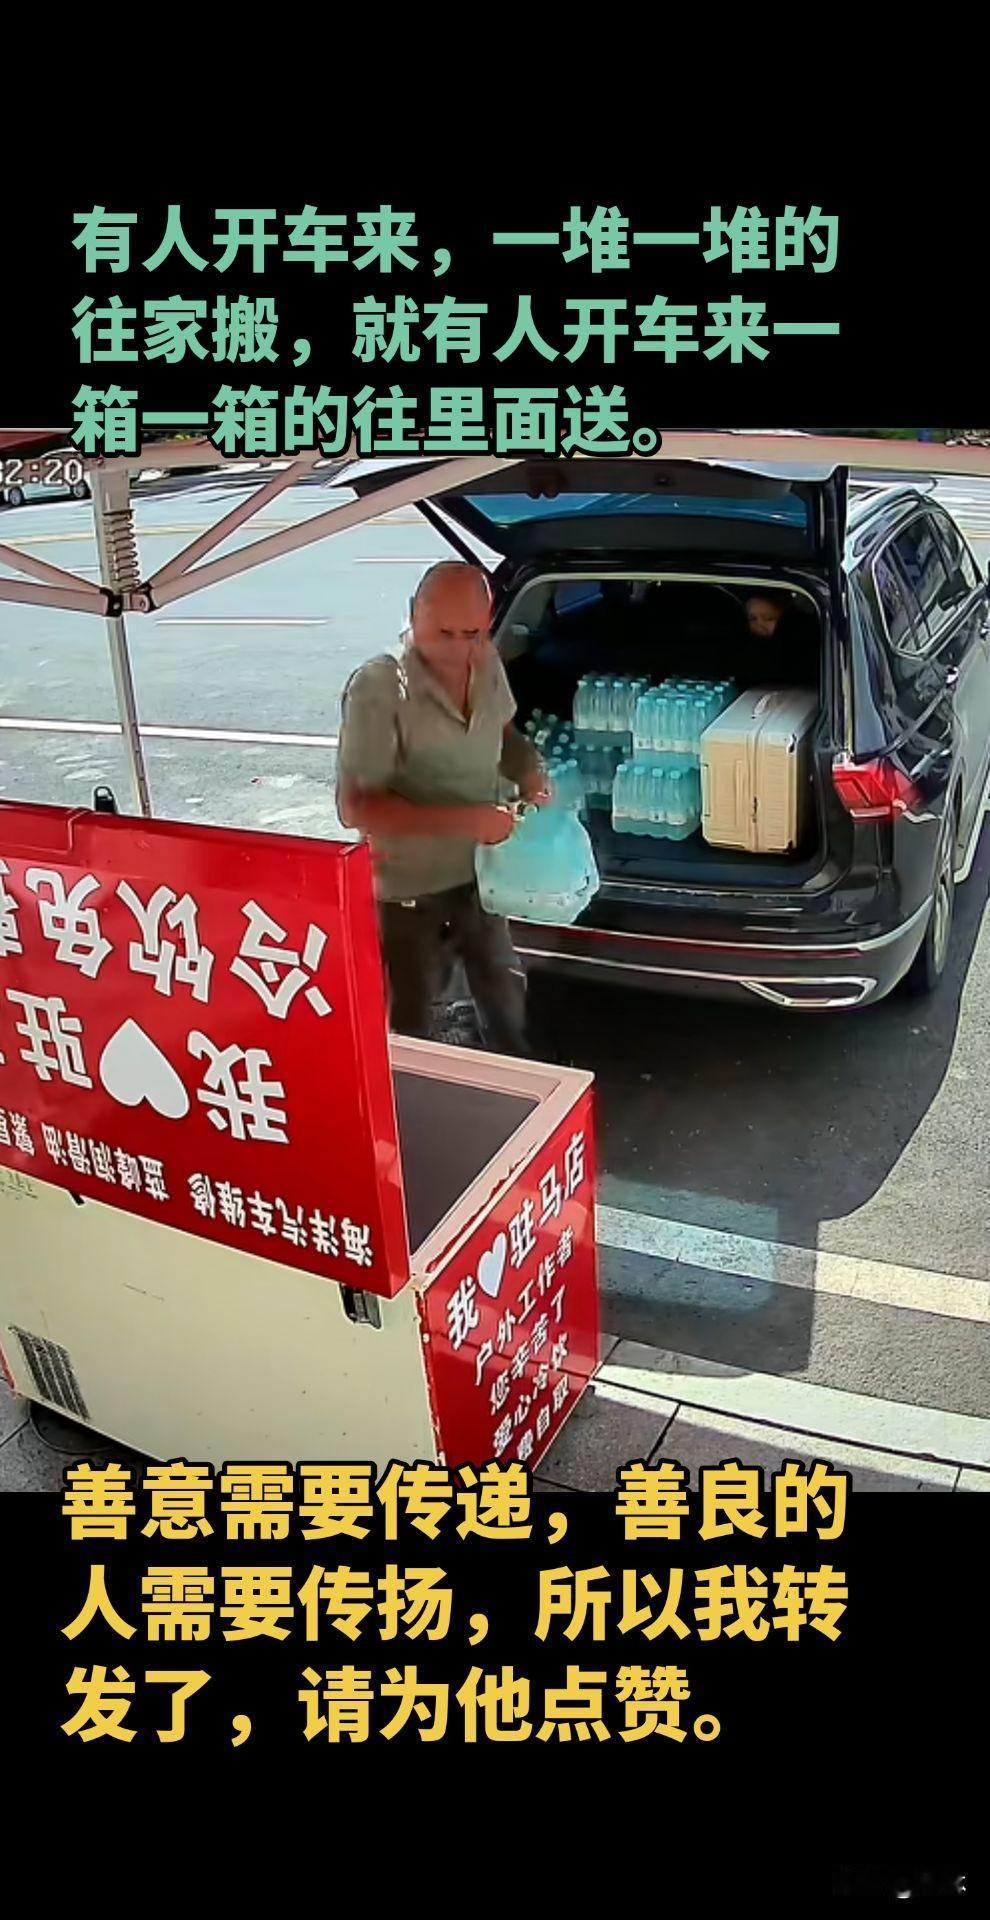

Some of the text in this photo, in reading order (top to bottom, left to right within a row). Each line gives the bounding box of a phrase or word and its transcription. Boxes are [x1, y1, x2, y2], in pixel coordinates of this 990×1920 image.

[0, 988, 289, 1144] 我 驻
[187, 1173, 373, 1267] 海洋汽车维修
[508, 1130, 586, 1270] 驻马店
[474, 1224, 575, 1388] 户外工作者
[489, 1285, 568, 1417] 您辛苦了
